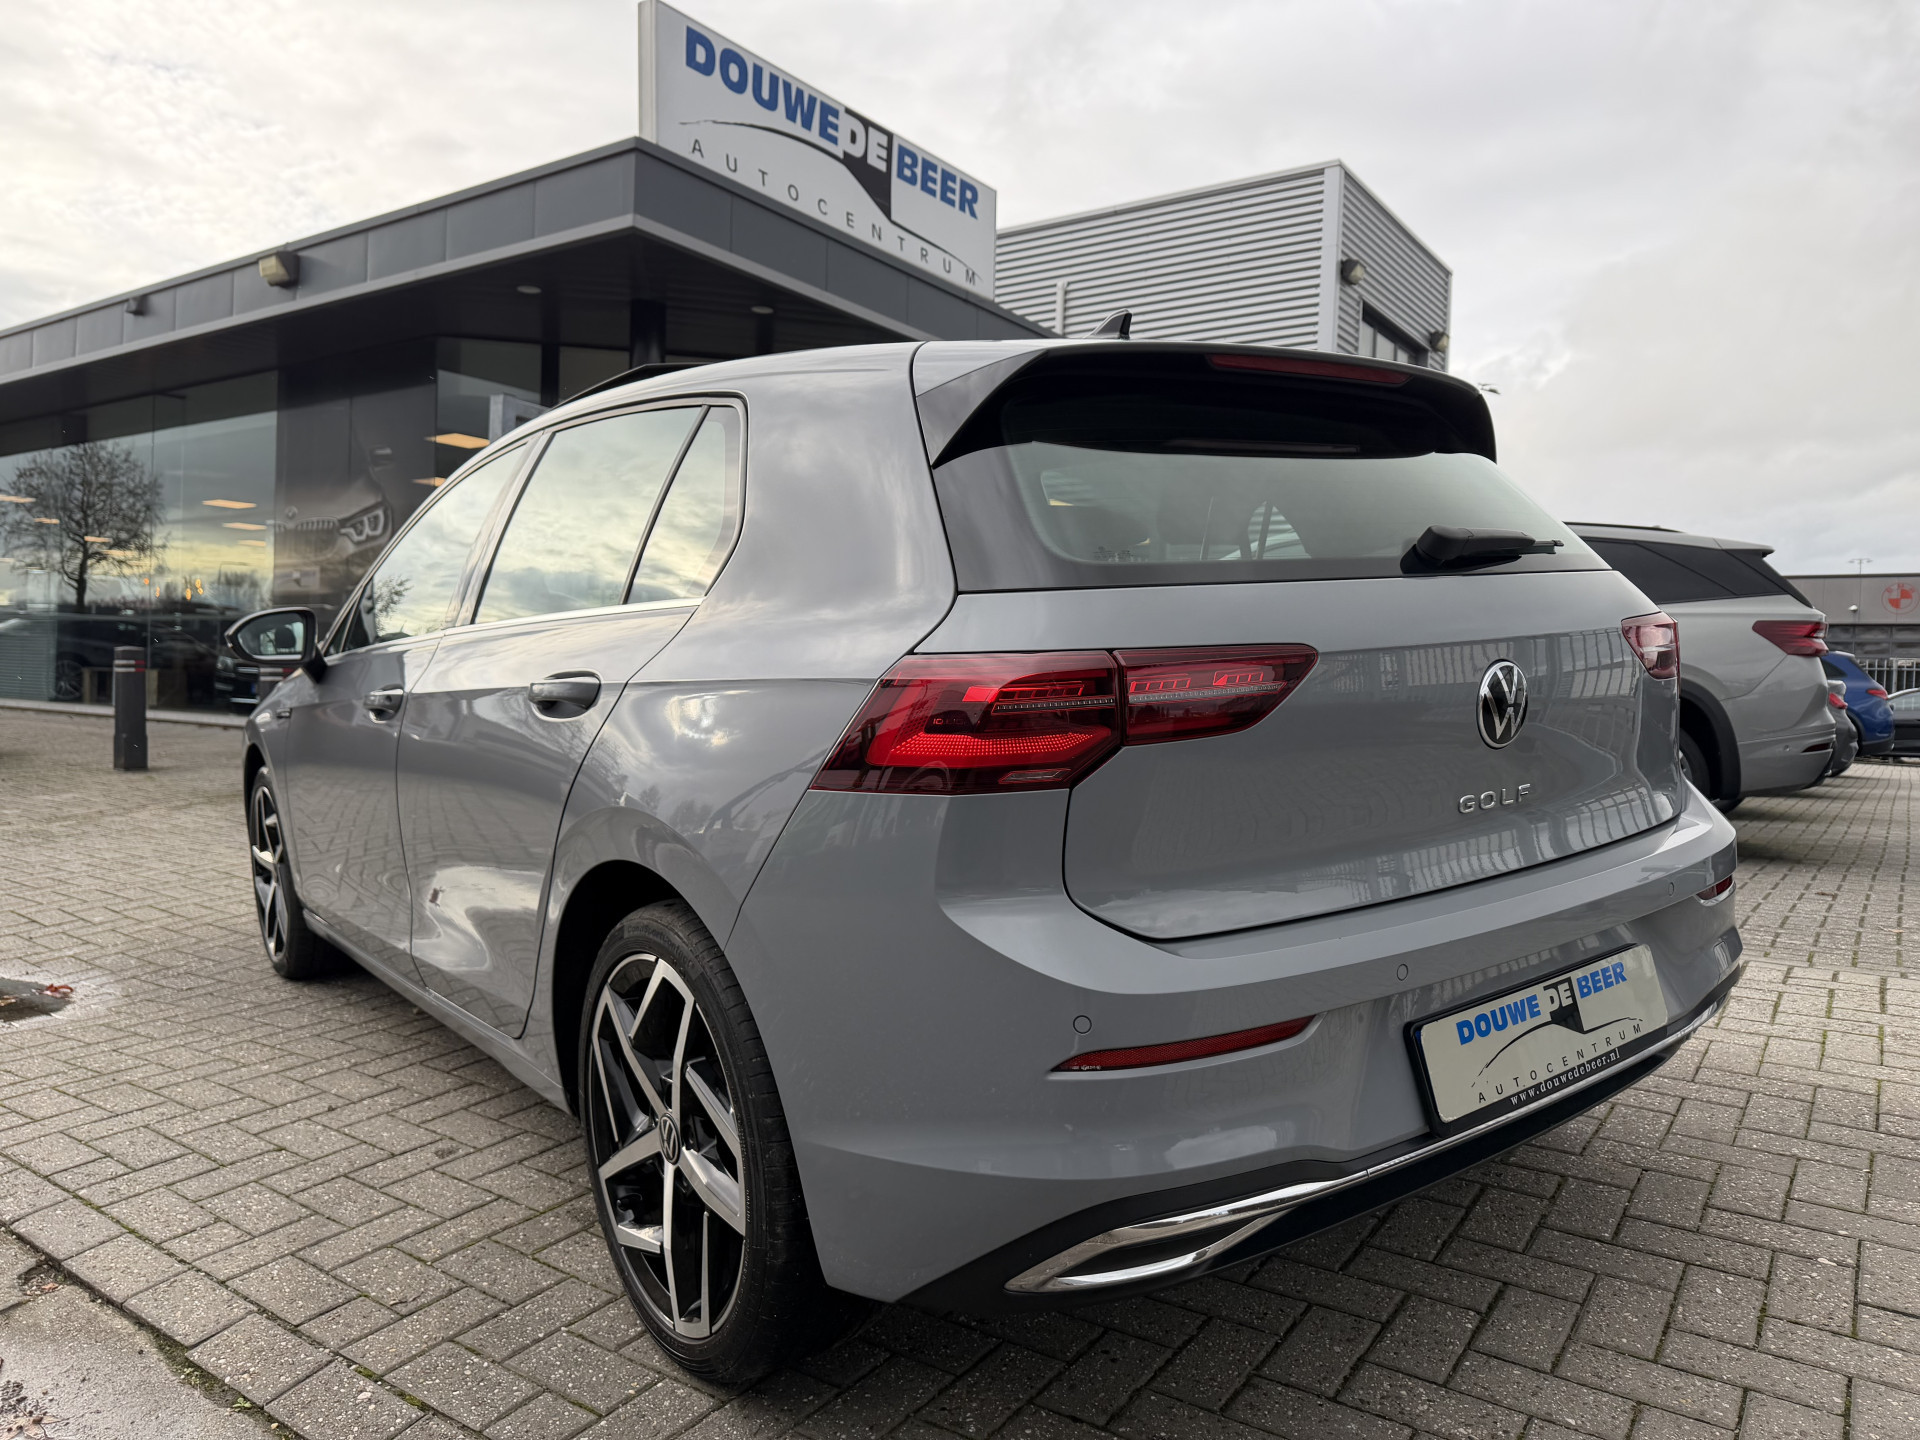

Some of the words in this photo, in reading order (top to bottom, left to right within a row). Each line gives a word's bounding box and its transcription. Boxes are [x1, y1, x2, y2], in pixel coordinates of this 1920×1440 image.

[685, 25, 840, 147] DOUWE
[843, 112, 888, 173] DE
[896, 143, 979, 220] BEER
[691, 138, 976, 286] AUTOCENTRUM
[1459, 783, 1531, 814] GOLF
[1456, 994, 1541, 1046] DOUWE
[1549, 981, 1574, 1012] DE
[1576, 961, 1628, 999] BEER
[1477, 1023, 1642, 1104] AUTOCENTRUM
[1510, 1047, 1621, 1106] www.douwedebeer.nl
